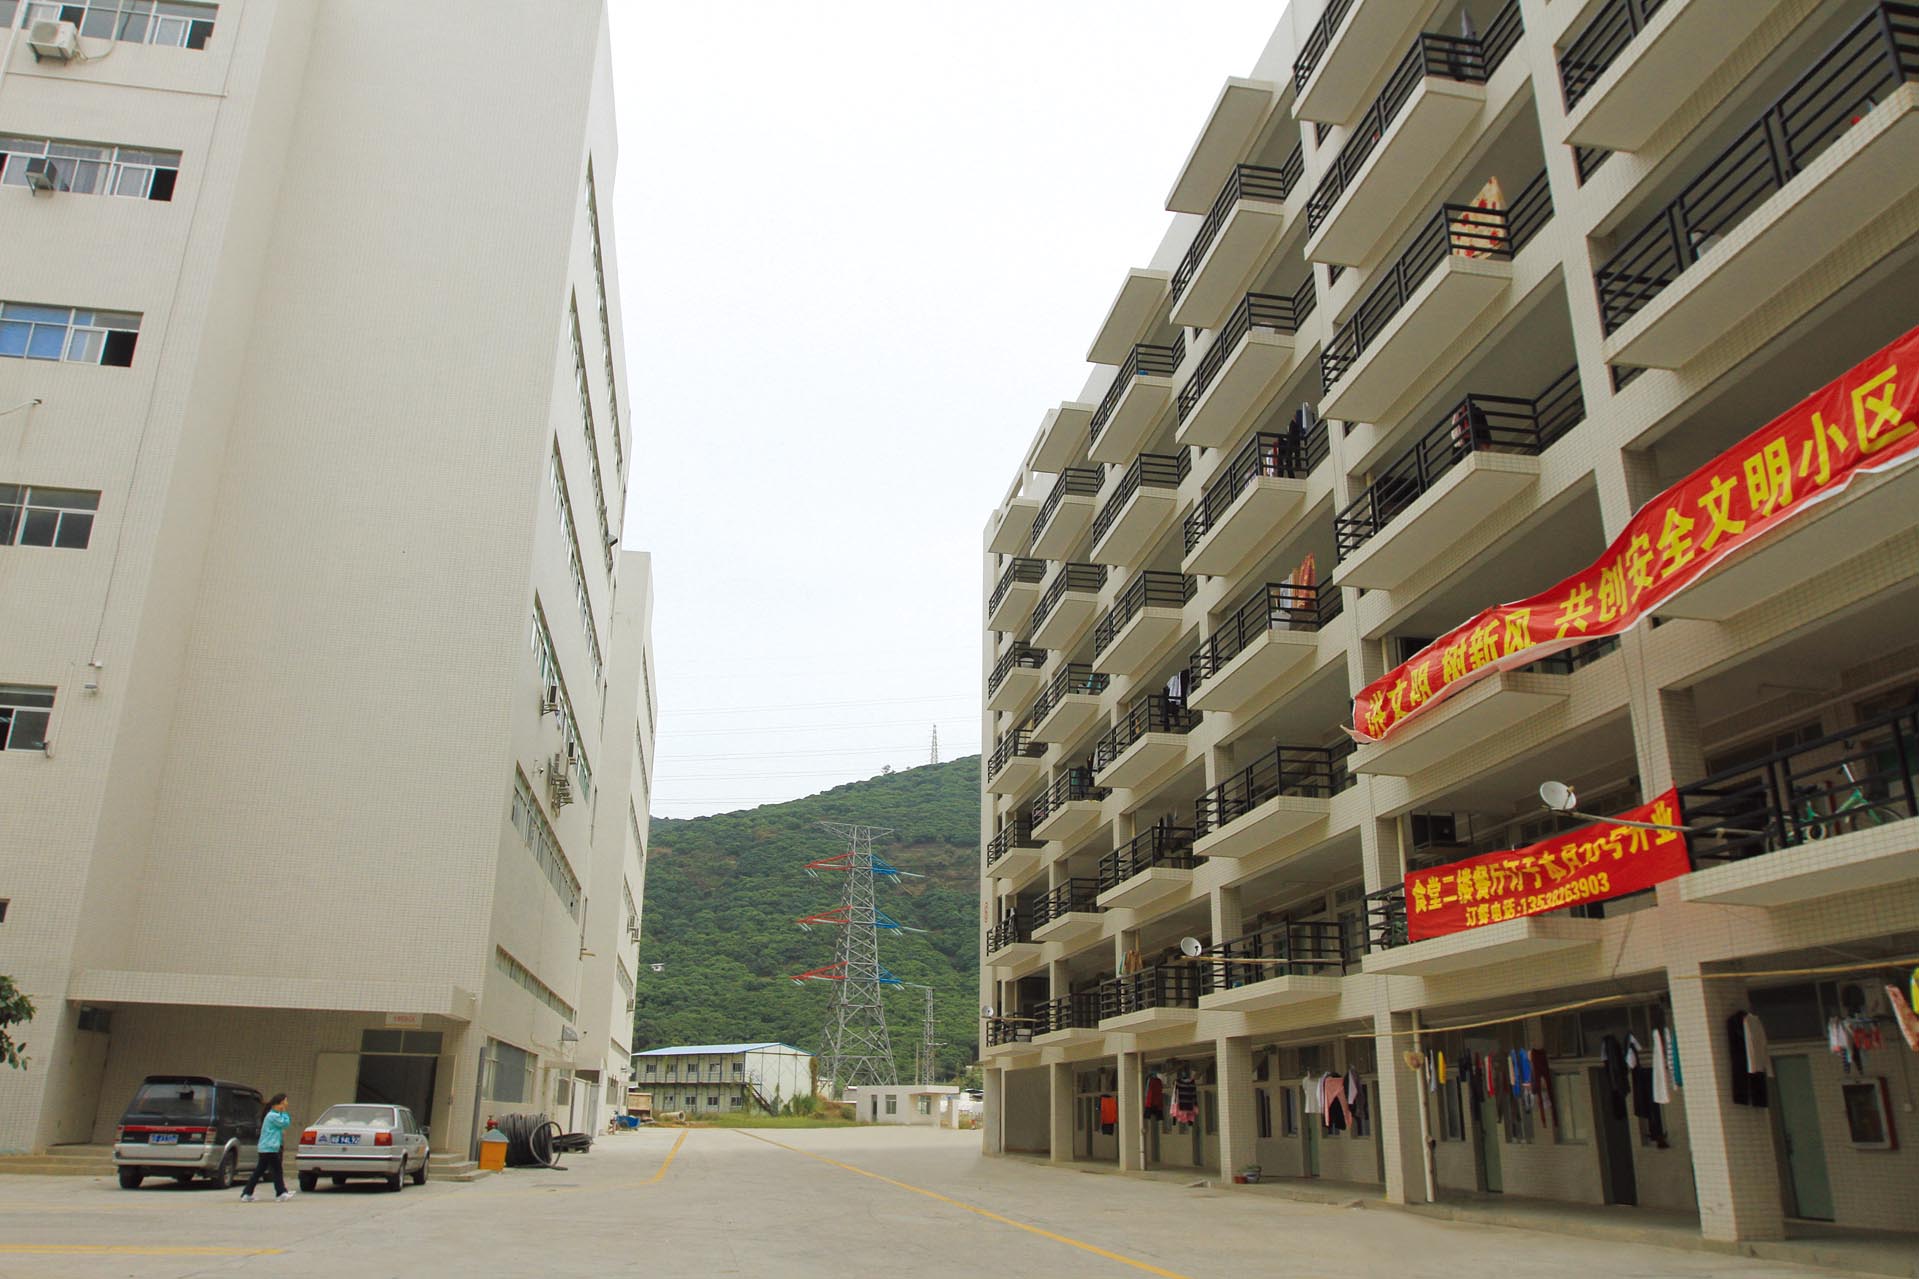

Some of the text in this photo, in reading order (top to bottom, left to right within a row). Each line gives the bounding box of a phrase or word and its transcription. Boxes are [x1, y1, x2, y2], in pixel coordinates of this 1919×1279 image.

[1554, 364, 1918, 639] 共创安全文明小区
